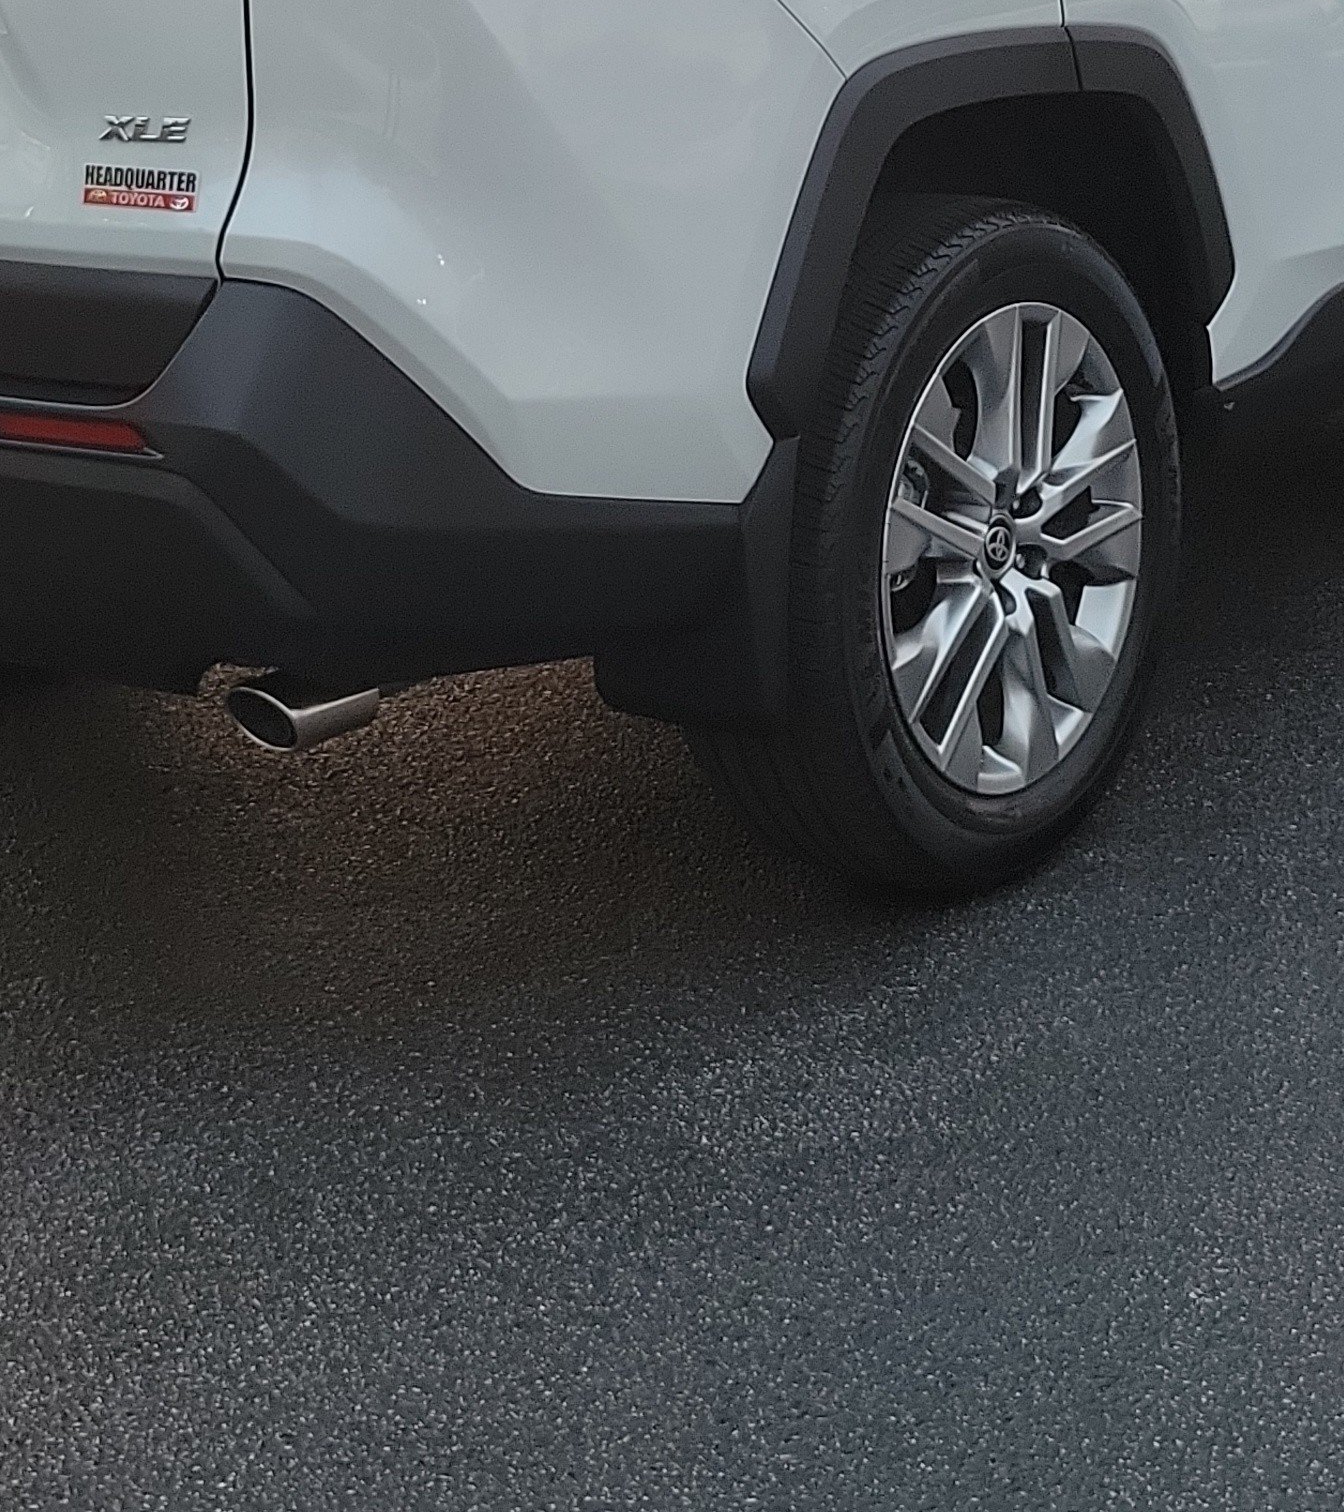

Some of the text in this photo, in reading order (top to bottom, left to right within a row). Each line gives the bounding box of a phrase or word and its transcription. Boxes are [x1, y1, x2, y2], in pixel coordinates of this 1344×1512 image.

[98, 115, 191, 143] XLE
[84, 164, 197, 193] HEADQUARTER
[110, 191, 166, 208] TOYOTA
